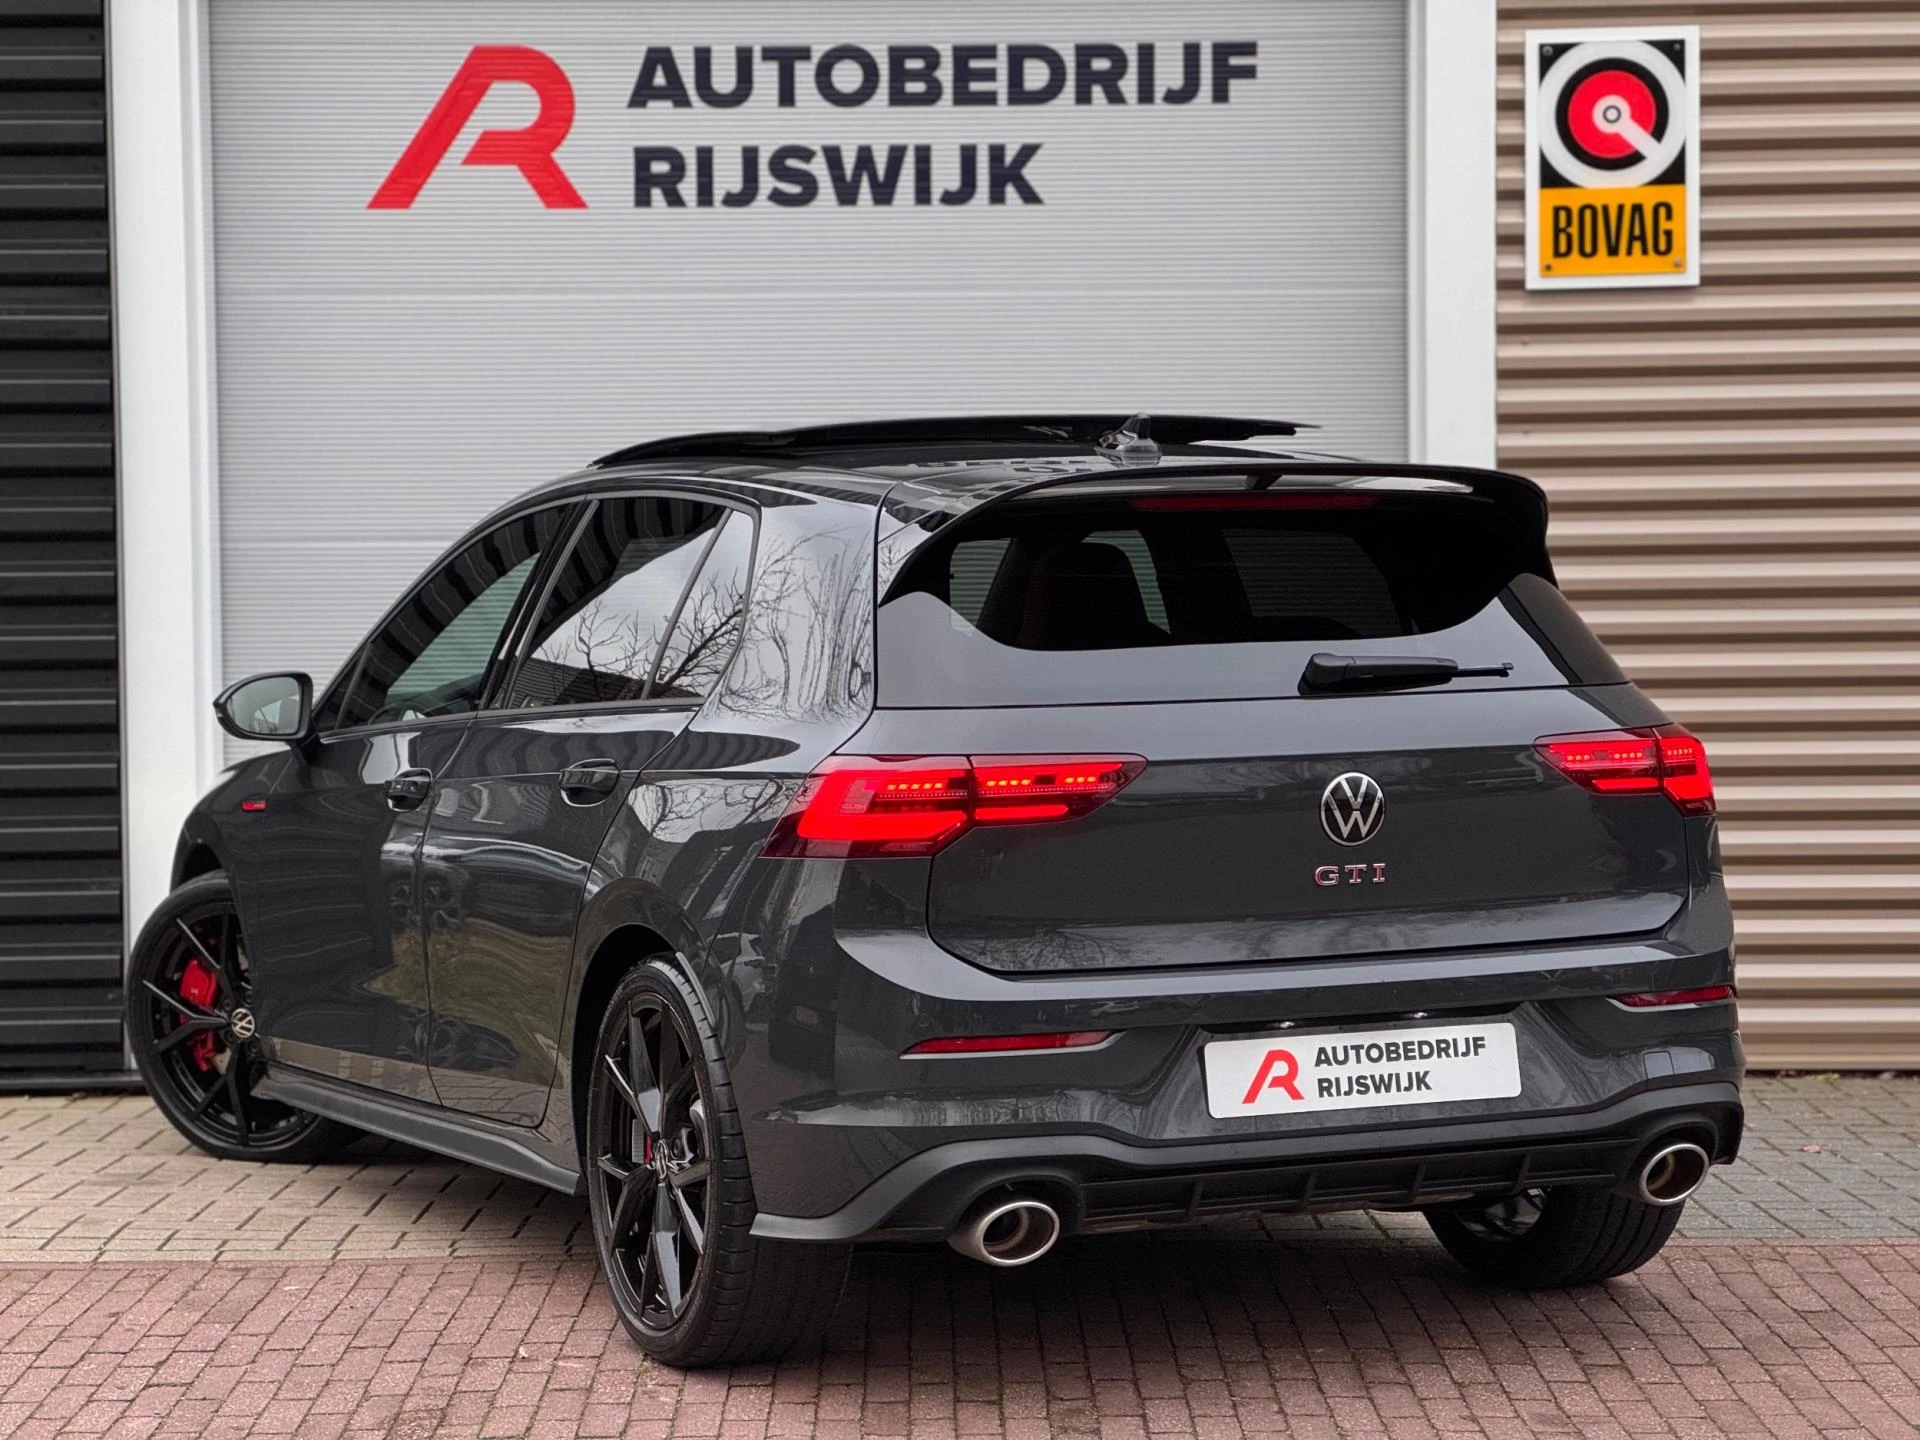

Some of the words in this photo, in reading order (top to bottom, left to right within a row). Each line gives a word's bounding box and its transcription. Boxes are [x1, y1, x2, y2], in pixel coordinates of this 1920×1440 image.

[628, 42, 1258, 108] AUTOBEDRIJF
[633, 144, 1044, 208] RIJSWIJK
[1552, 201, 1674, 259] BOVAG
[1314, 863, 1387, 886] GTI
[1314, 1036, 1486, 1067] AUTOBEDRIJF
[1317, 1071, 1432, 1098] RIJSWIJK
